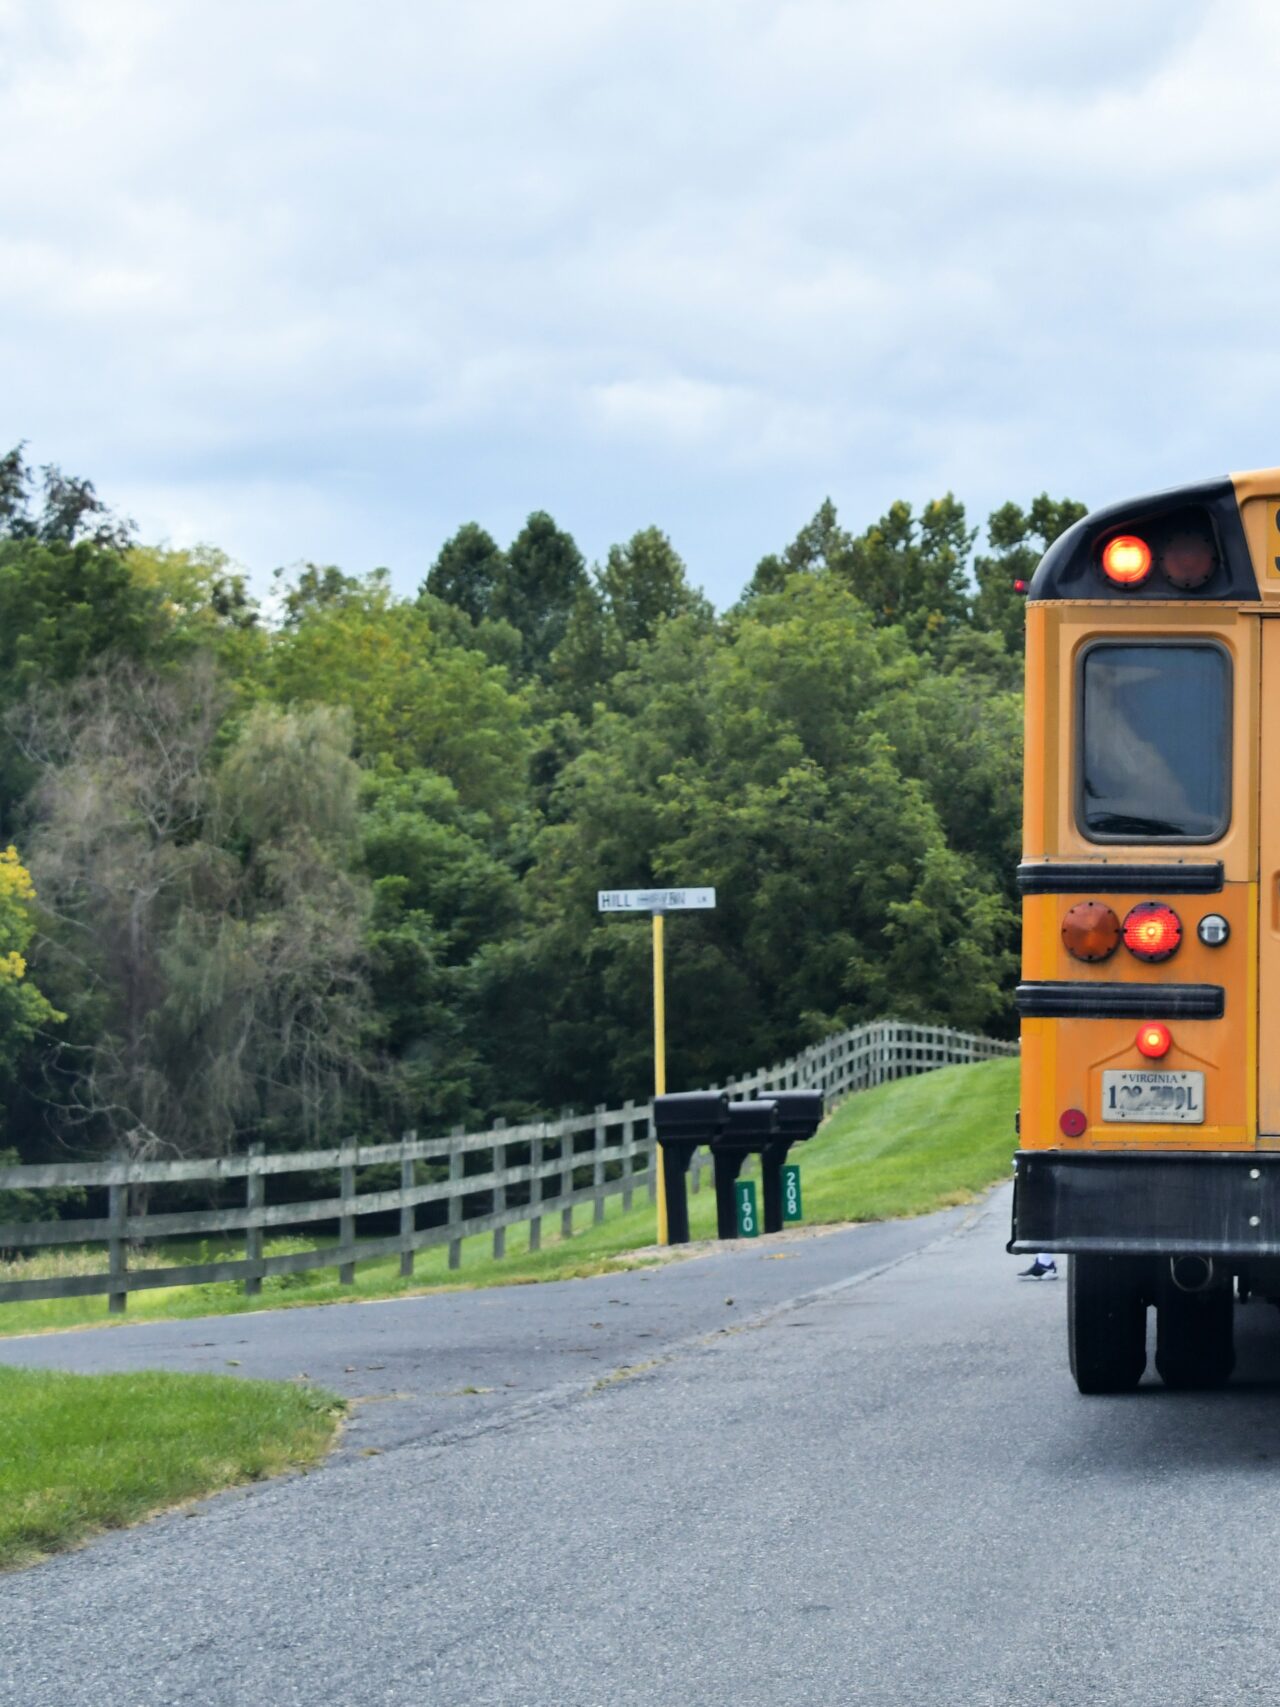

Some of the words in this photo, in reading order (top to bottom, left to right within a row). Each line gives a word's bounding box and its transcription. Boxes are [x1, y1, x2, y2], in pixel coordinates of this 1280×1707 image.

[601, 893, 632, 908] HILL
[1129, 1073, 1178, 1084] VIRGINIA
[786, 1171, 797, 1215] 208
[742, 1188, 754, 1232] 190
